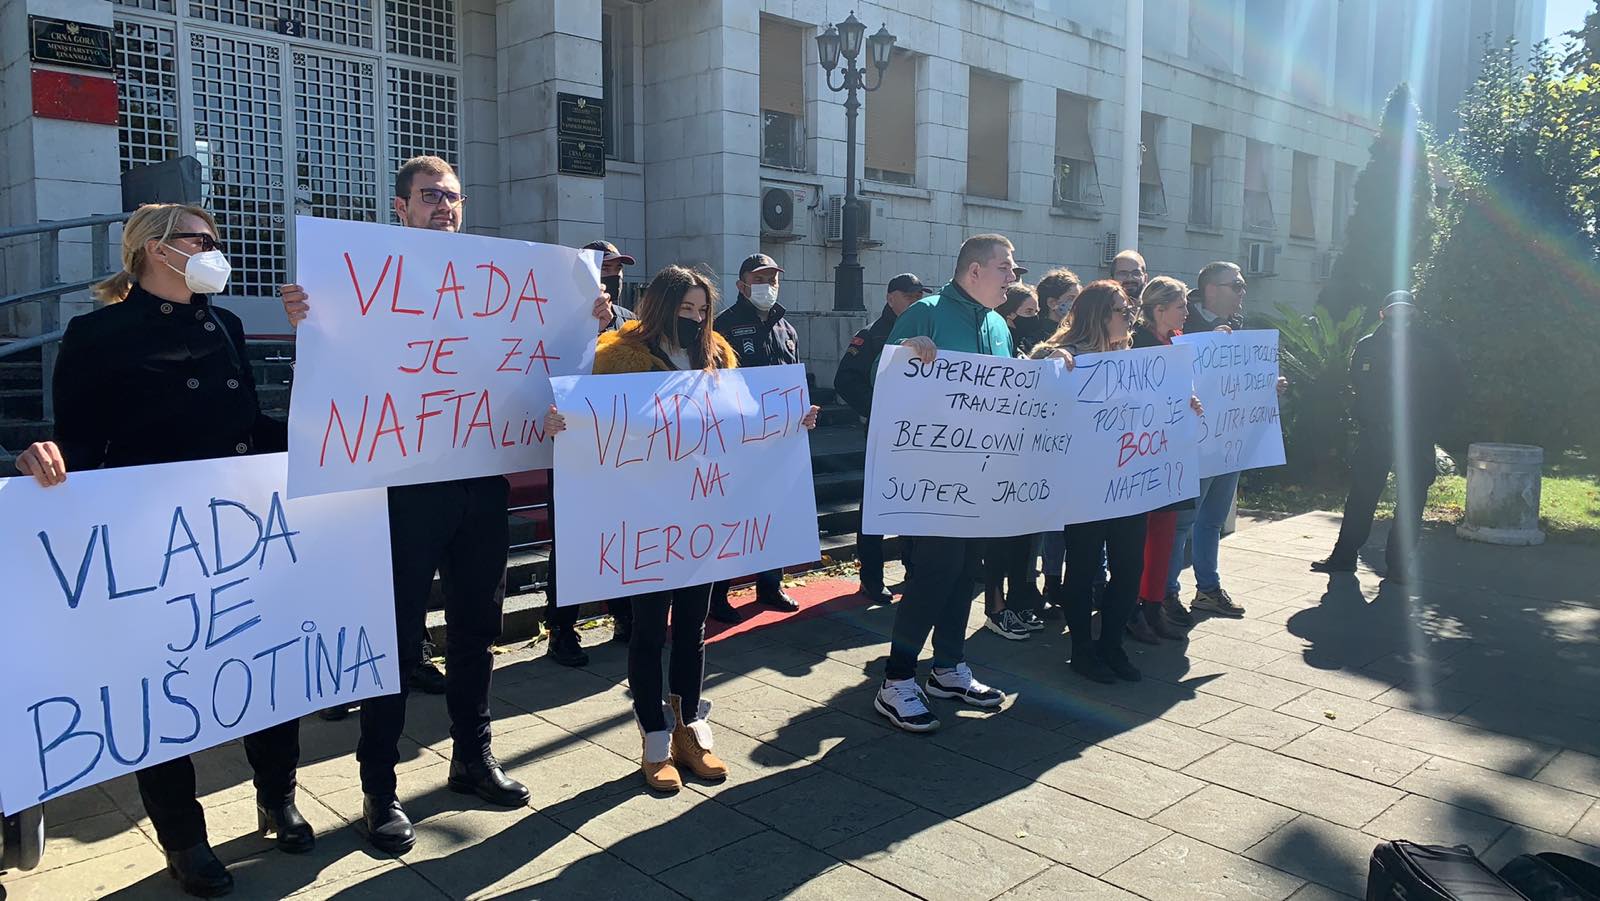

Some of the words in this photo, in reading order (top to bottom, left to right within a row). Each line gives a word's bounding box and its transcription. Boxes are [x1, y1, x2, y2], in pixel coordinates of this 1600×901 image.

[50, 32, 72, 42] CRNA
[73, 35, 95, 46] GORA
[286, 21, 294, 34] 2
[47, 43, 100, 56] MINISTARSTVO
[55, 51, 93, 62] FINANSIJA
[344, 251, 548, 325] VLADA
[397, 336, 469, 374] JE
[496, 338, 561, 375] ZA
[903, 357, 1042, 390] SUPERHEROJI
[1075, 356, 1167, 403] ZDRAVKO
[945, 392, 1058, 419] TRANZICIJE:
[1093, 402, 1155, 432] POŠTO
[1165, 396, 1185, 425] JE
[319, 389, 546, 468] NAFTALIN
[585, 391, 726, 468] VLADA
[736, 386, 804, 444] LETI
[893, 420, 1024, 452] BEZOLOVNI
[1032, 428, 1072, 455] MICKEY
[1117, 429, 1168, 467] BOCA
[690, 462, 730, 500] NA
[882, 476, 976, 505] SUPER
[991, 478, 1051, 505] JACOB
[37, 491, 300, 609] VLADA
[599, 512, 772, 585] KLEROZIN
[166, 577, 262, 653] JE
[27, 620, 386, 801] BUŠOTINA
